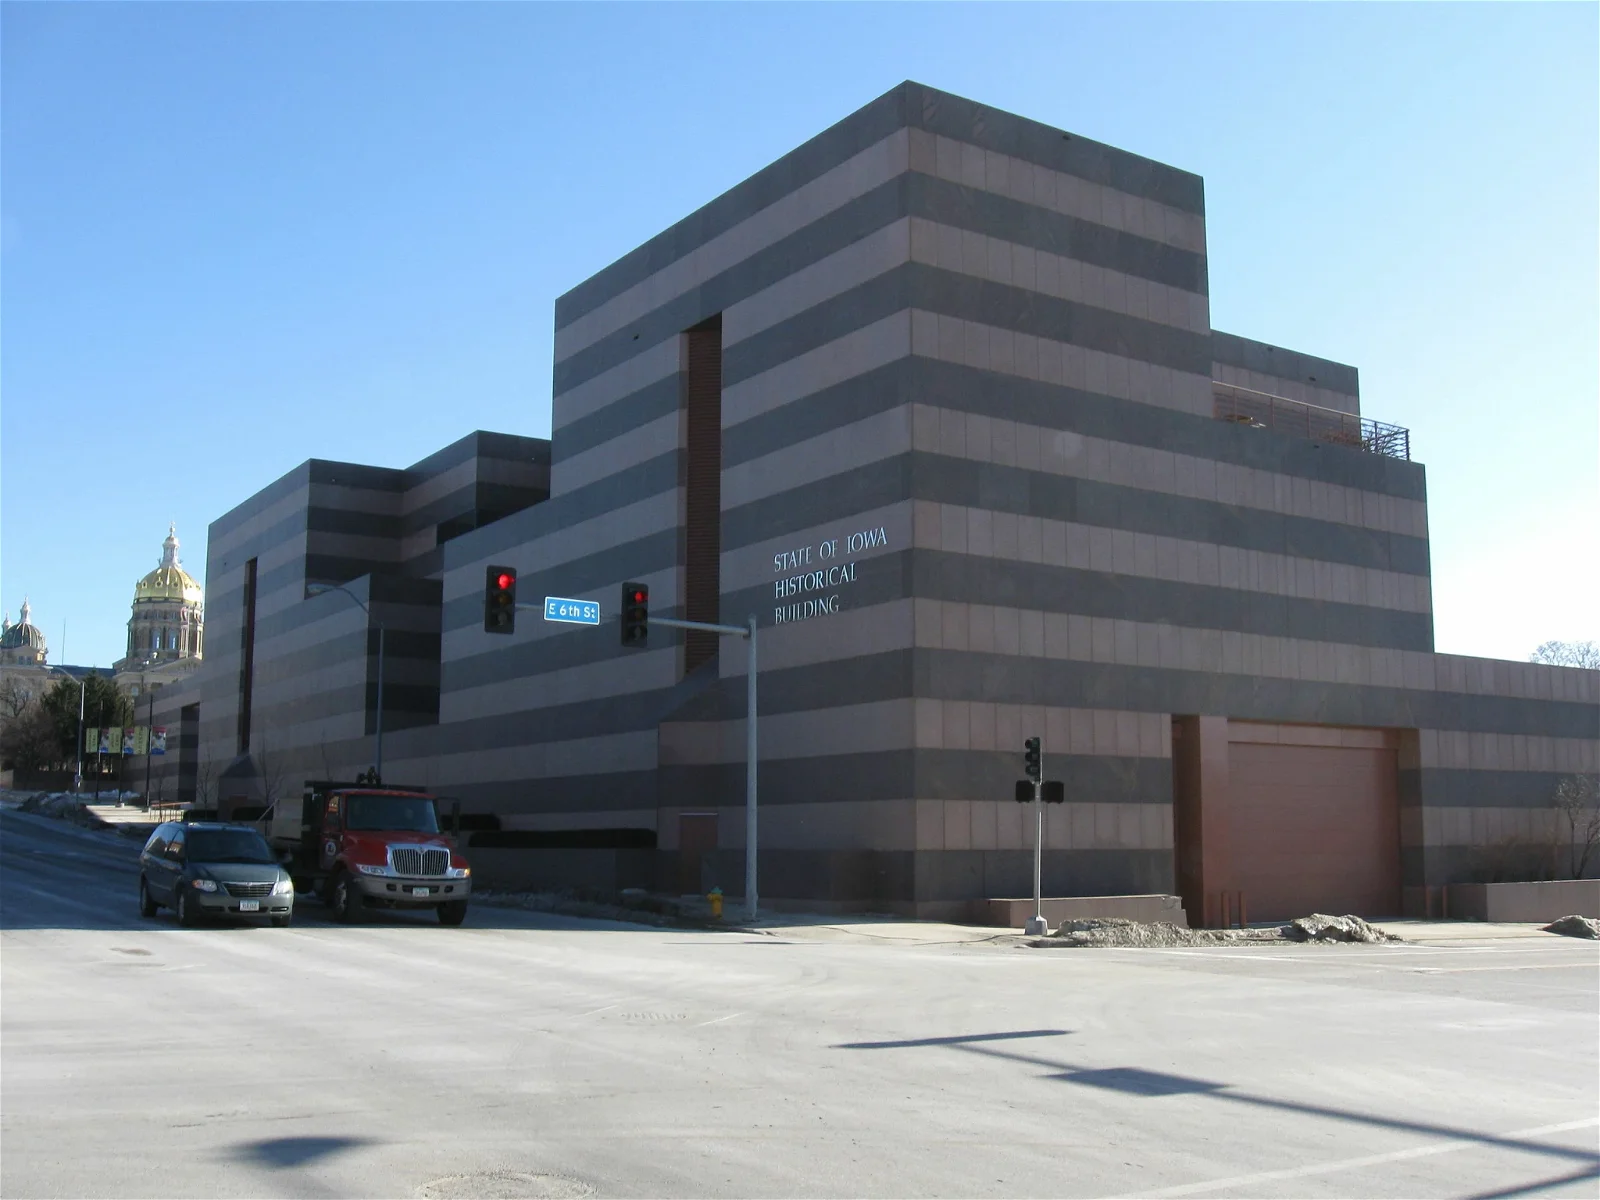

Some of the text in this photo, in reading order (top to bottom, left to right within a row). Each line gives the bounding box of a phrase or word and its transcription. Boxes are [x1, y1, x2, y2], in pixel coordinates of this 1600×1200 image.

[774, 526, 887, 572] STATE OF IOWA
[775, 562, 858, 599] HISTORICAL
[548, 603, 596, 619] E 6th St
[775, 595, 839, 624] BUILDING
